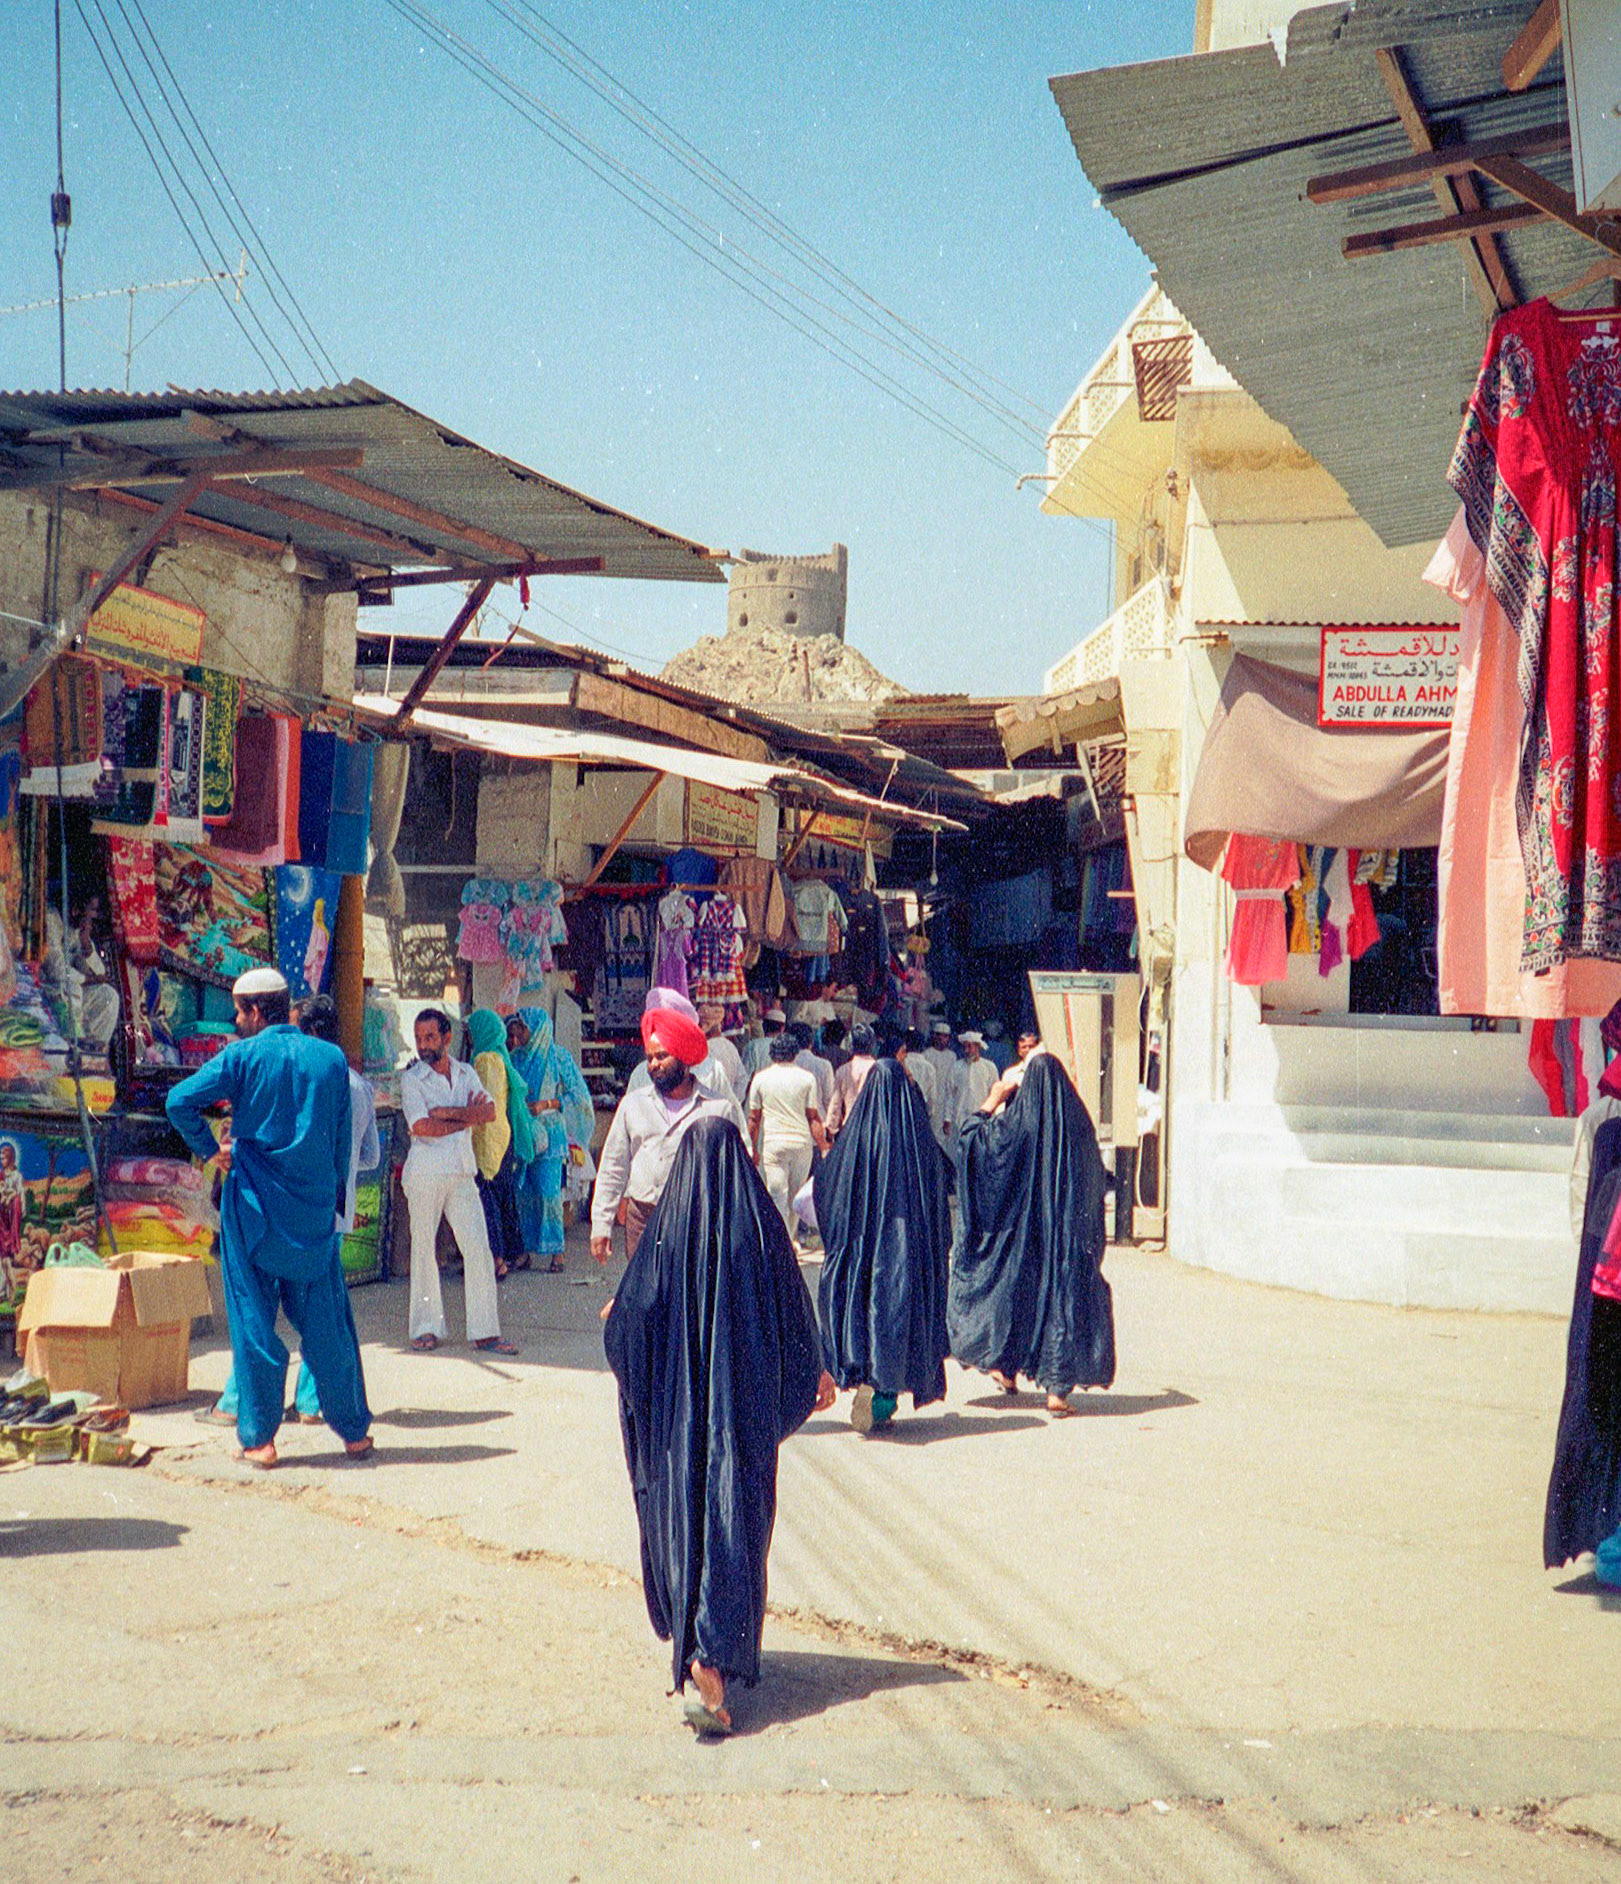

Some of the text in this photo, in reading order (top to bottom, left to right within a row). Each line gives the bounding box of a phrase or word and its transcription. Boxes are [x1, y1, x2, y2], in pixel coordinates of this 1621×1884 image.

[1333, 685, 1407, 702] ABDULLA
[1336, 705, 1455, 718] SALE OF READYMAD
